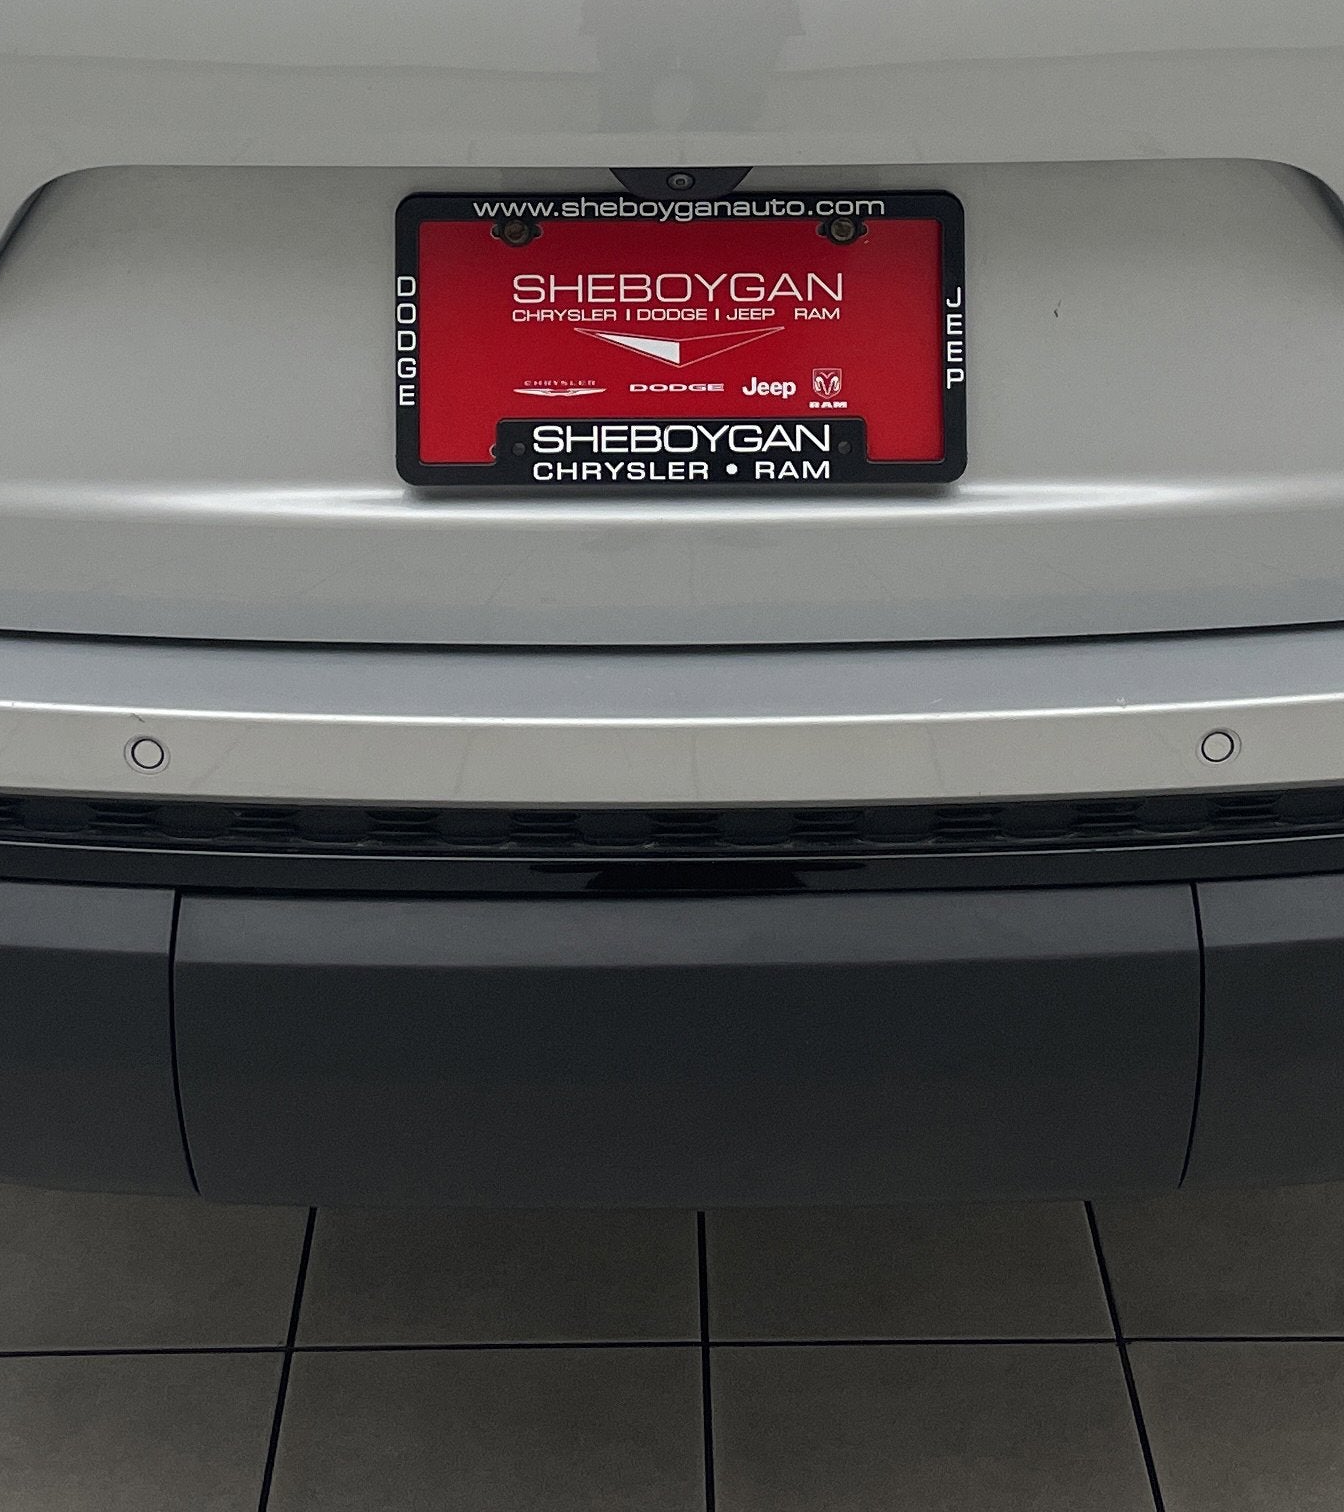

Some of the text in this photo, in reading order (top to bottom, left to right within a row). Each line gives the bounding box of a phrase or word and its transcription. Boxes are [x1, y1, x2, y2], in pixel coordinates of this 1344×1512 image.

[473, 197, 885, 222] www.sheboyganauto.com
[513, 273, 843, 304] SHEBOYGAN
[512, 307, 840, 322] CHRYSLER DODGE JEEP RAM
[396, 276, 416, 406] DODGE
[945, 287, 963, 390] JEEP
[629, 383, 725, 392] DODGE
[742, 377, 796, 399] Jeep
[809, 401, 848, 409] RAM
[533, 424, 831, 453] SHEBOYGAN
[533, 461, 830, 481] CHRYSLER RAM
